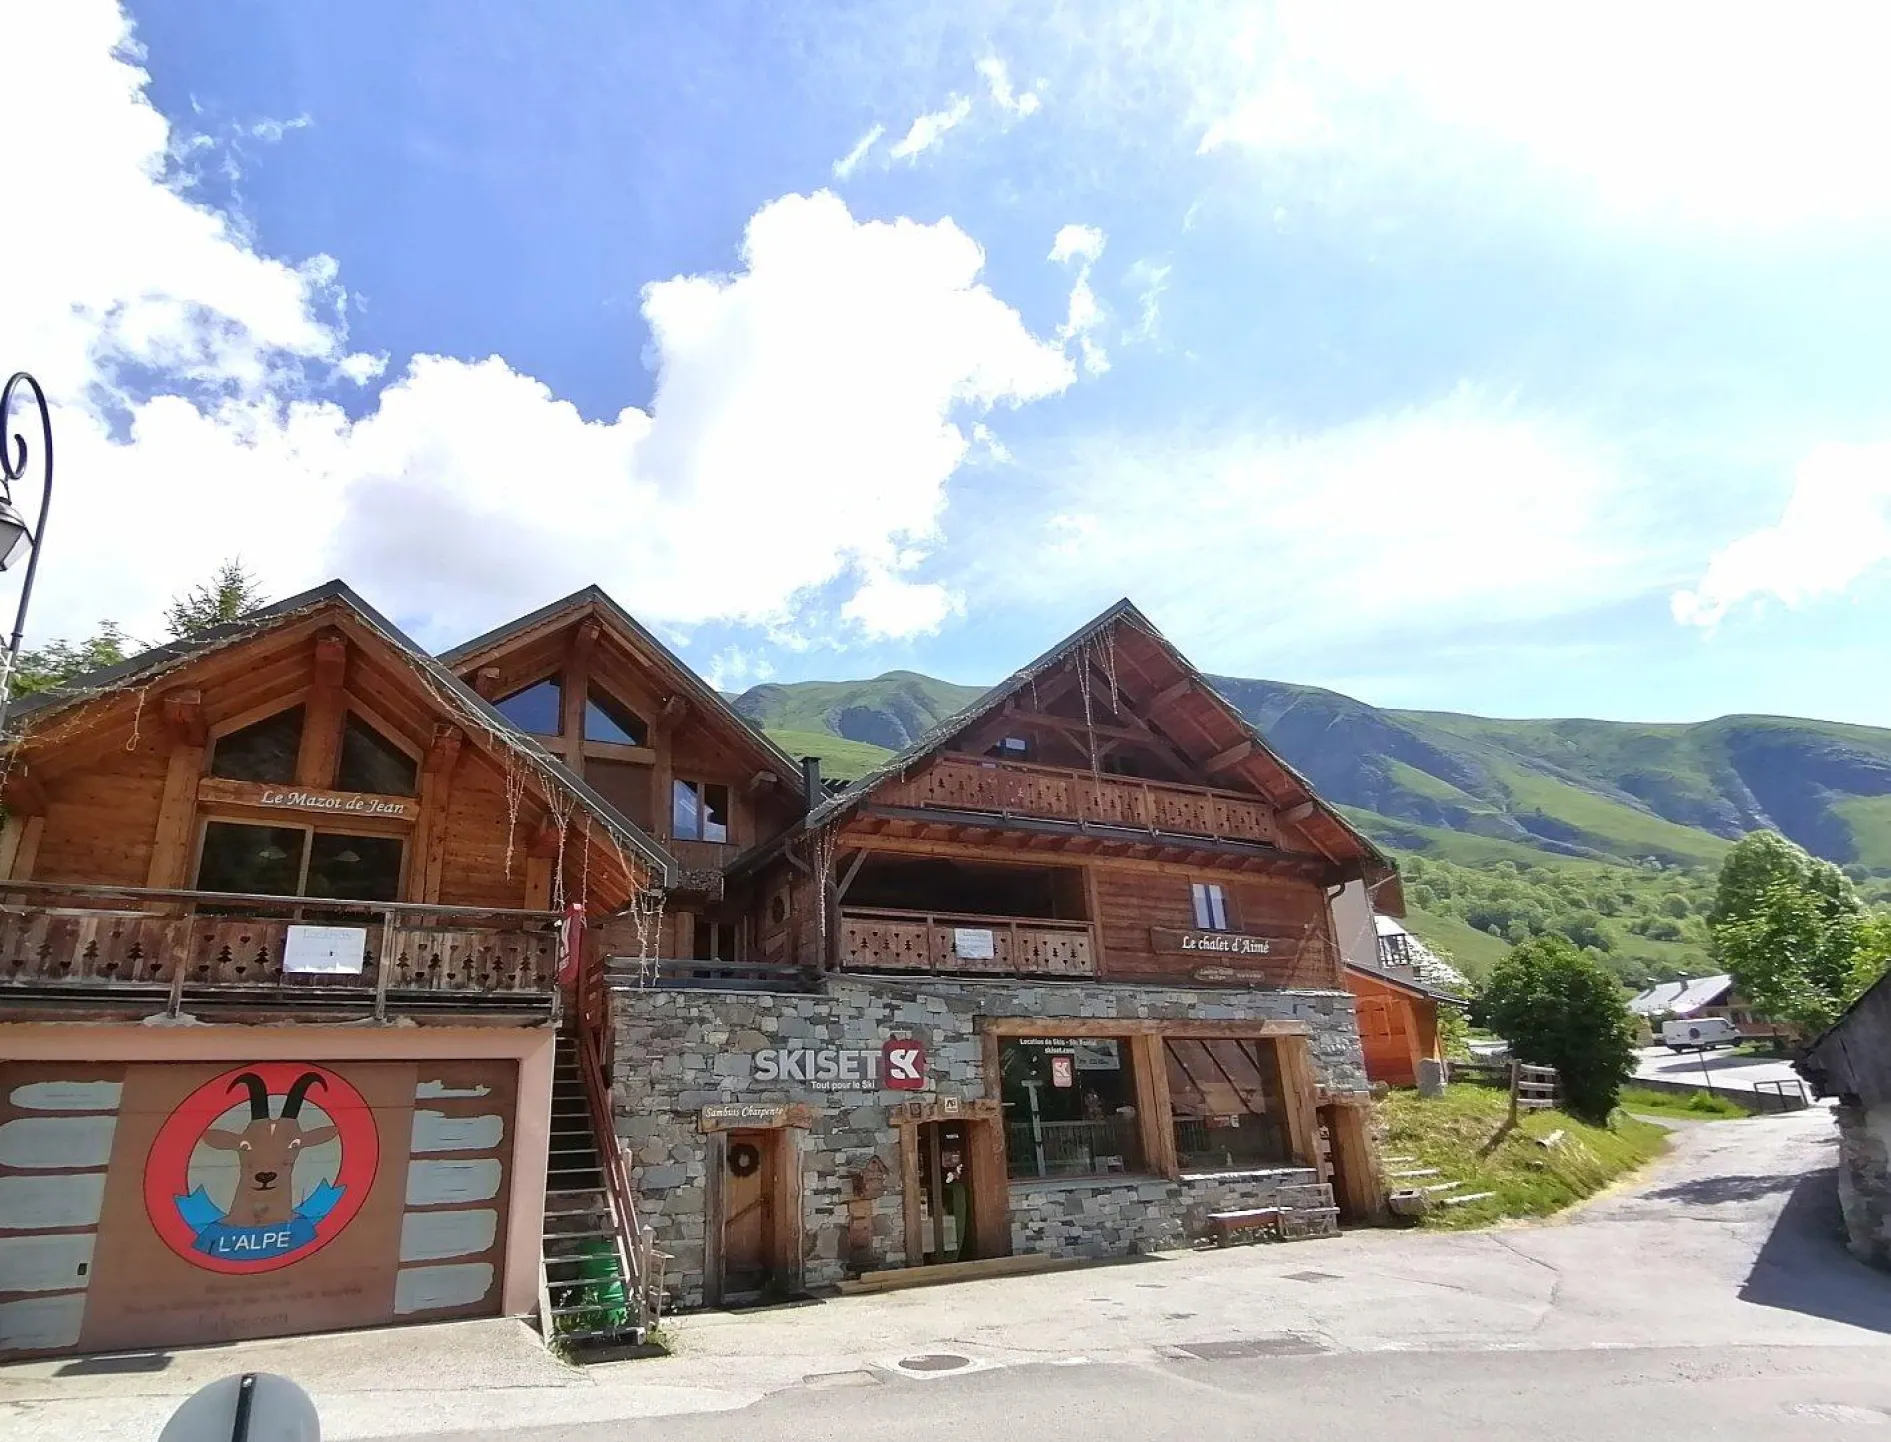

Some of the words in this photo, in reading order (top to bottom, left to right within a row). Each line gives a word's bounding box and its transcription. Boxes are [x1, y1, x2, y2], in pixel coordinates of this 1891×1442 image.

[262, 790, 281, 804] Le
[284, 792, 342, 809] Mazot
[345, 795, 364, 811] de
[366, 799, 404, 814] Jean
[1182, 935, 1197, 949] Le
[1198, 935, 1229, 952] chalet
[1231, 938, 1270, 954] d'Aimé
[754, 1049, 883, 1081] SKISET
[811, 1081, 830, 1090] Tout
[831, 1082, 851, 1091] pour
[852, 1080, 860, 1089] le
[862, 1079, 875, 1089] Ski
[219, 1230, 292, 1252] L'ALPE
